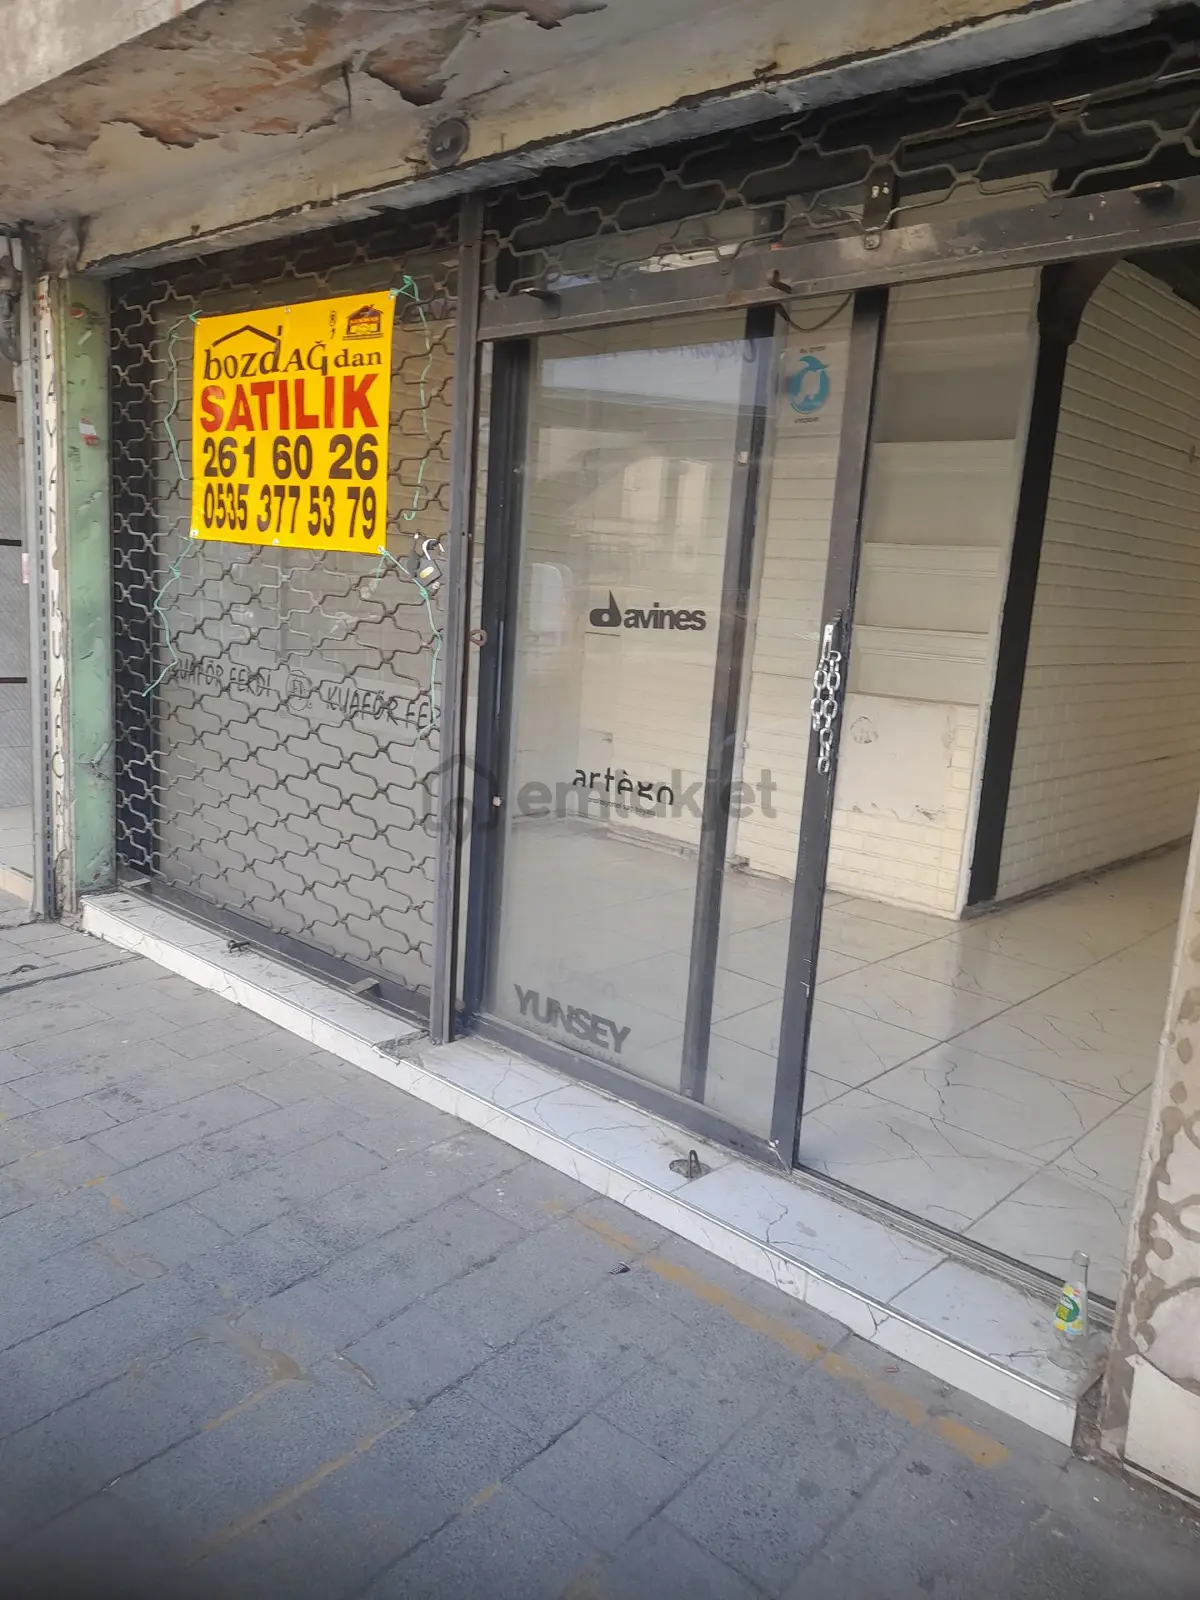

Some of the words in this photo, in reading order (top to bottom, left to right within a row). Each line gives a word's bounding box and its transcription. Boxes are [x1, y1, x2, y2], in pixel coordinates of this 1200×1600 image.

[200, 373, 380, 433] SATILIK
[203, 436, 256, 479] 261
[272, 434, 313, 480] 60
[328, 433, 379, 480] 26
[203, 482, 250, 531] 0535
[256, 484, 301, 533] 377
[307, 485, 335, 537] 53
[347, 486, 377, 540] 79
[589, 588, 707, 631] davines
[513, 983, 632, 1054] YUNSEY
